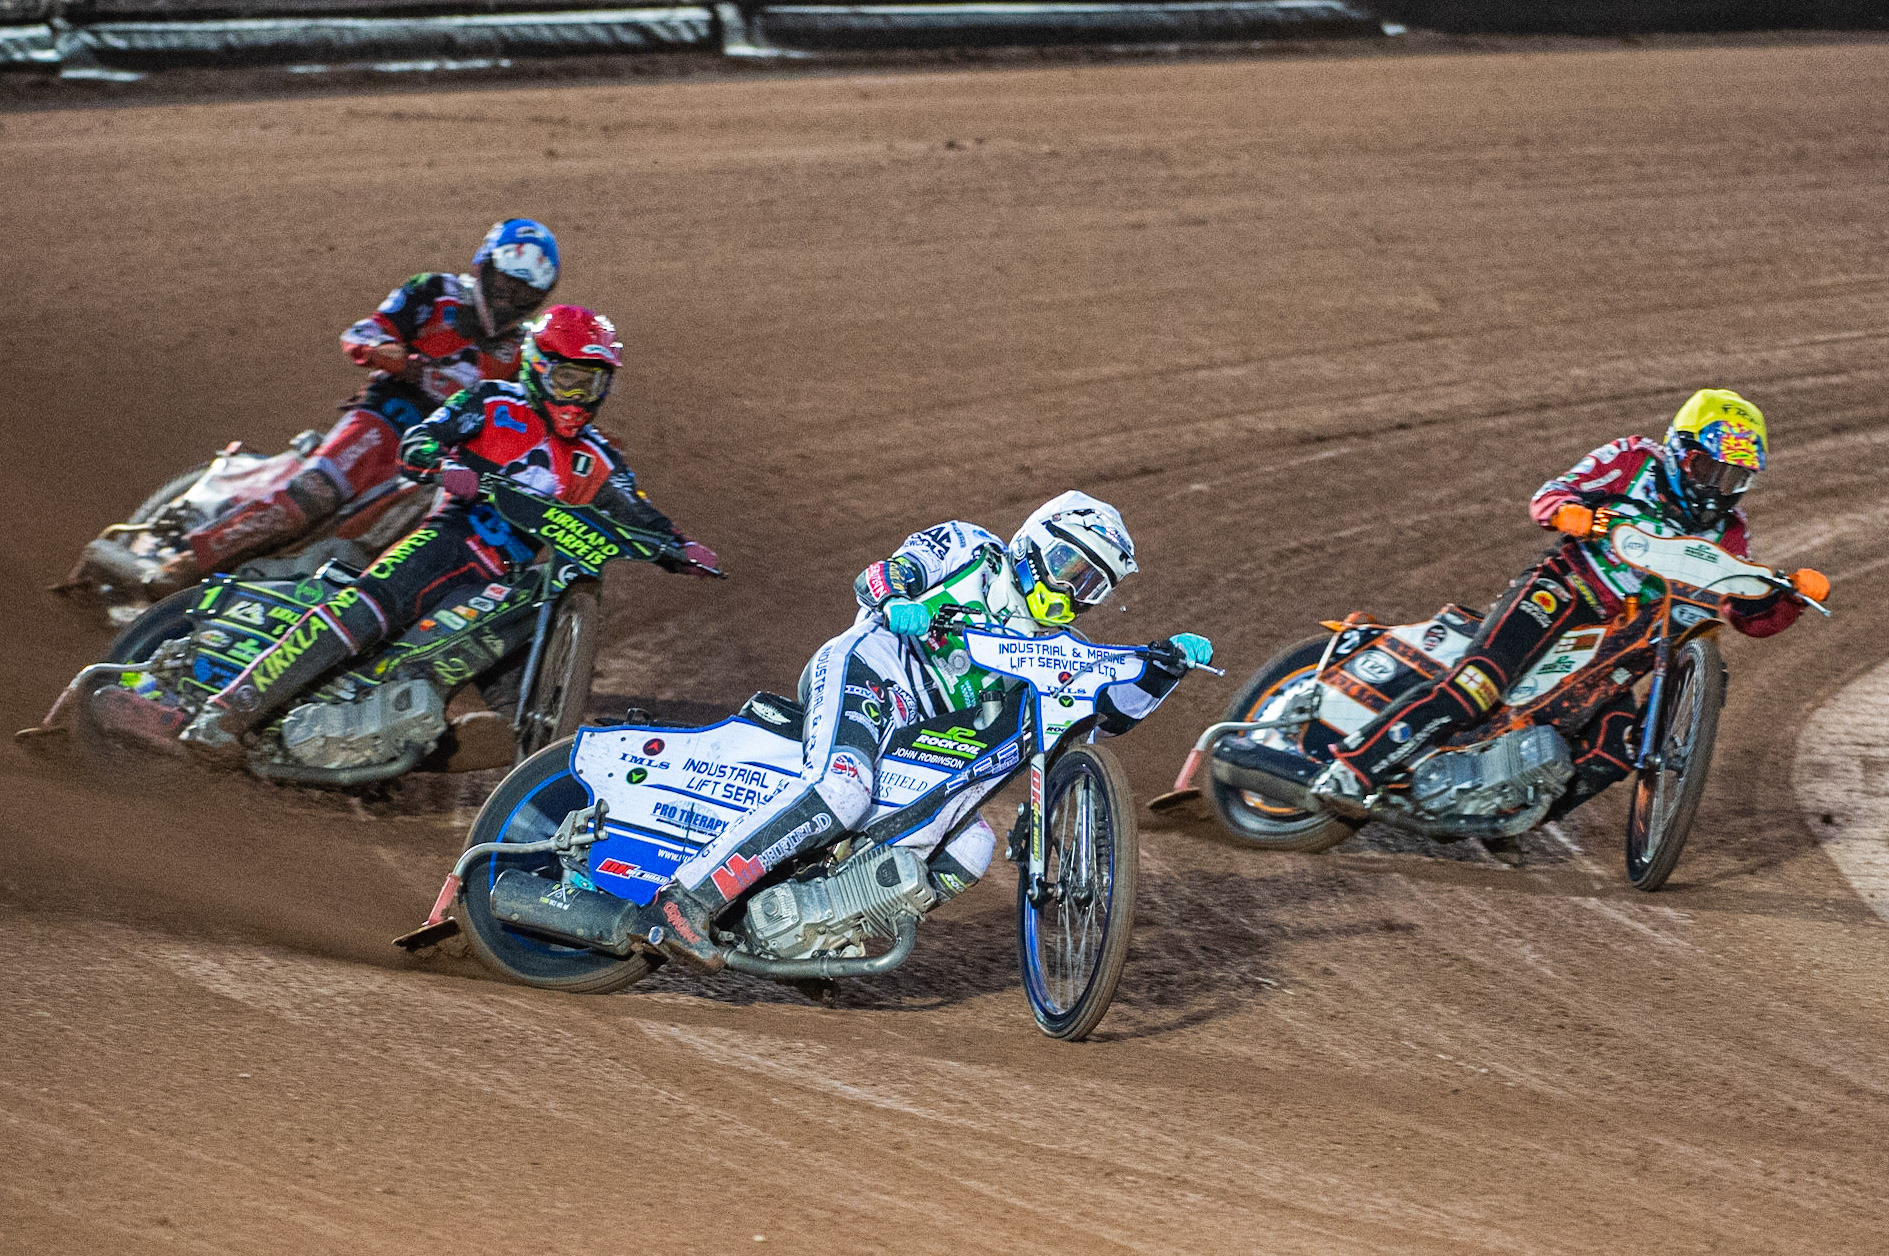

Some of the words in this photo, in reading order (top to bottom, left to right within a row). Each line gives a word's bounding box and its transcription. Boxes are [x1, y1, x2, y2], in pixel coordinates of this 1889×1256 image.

[542, 507, 619, 556] KIRKLAND
[540, 524, 607, 565] CARPETS
[198, 586, 224, 610] 1
[252, 587, 358, 693] KIRKLAND
[998, 643, 1067, 657] INDUSTRIAL
[1072, 648, 1082, 658] &
[1336, 630, 1360, 655] 2
[1010, 657, 1034, 669] LIFT
[1038, 657, 1093, 673] SERVICES
[1098, 665, 1117, 678] LTD
[915, 734, 955, 750] ROCK
[955, 742, 981, 755] OIL
[619, 752, 672, 770] IMLS
[892, 747, 917, 760] JOHN
[918, 750, 965, 770] ROBINSON
[682, 758, 770, 789] INDUSTRIAL
[686, 776, 721, 796] LIFT
[653, 802, 677, 818] PRO
[679, 809, 730, 832] THERAPY
